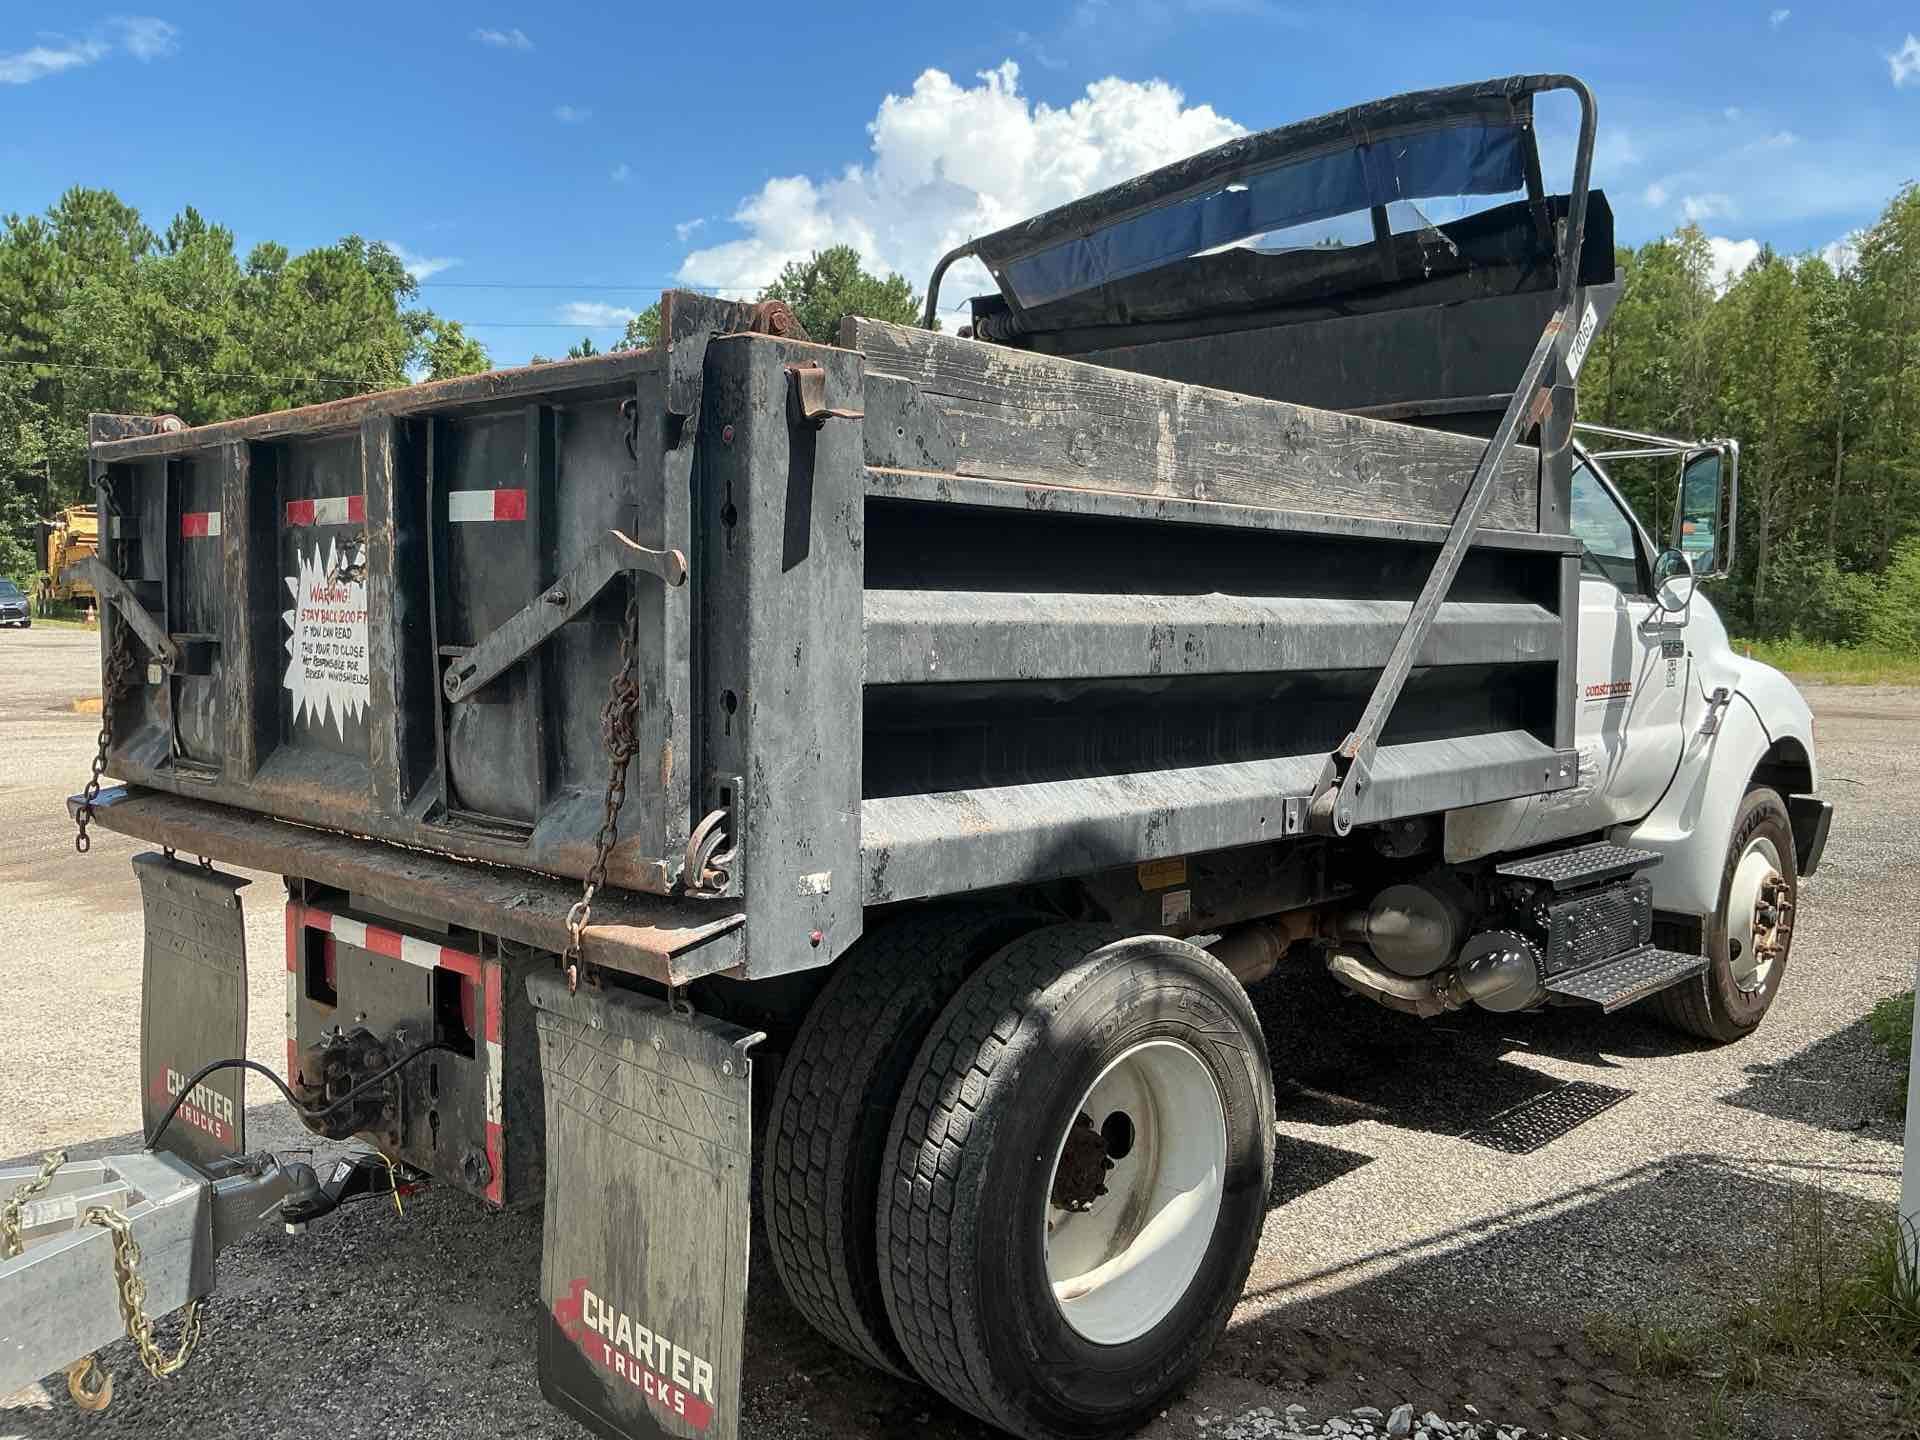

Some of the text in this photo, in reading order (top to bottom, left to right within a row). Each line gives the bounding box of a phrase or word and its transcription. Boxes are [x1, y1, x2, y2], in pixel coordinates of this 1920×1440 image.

[301, 608, 320, 622] STAY
[320, 609, 338, 624] BACK
[339, 610, 356, 623] 200
[303, 625, 352, 639] IF YOU CAN READ
[302, 642, 364, 657] THIS YOUR TO CLOSE
[303, 655, 358, 672] NOT RESPONSIBLE FOR
[328, 671, 369, 685] WINDSHIELDS
[583, 1288, 714, 1404] CHARTER
[603, 1343, 686, 1416] TRUCKS
